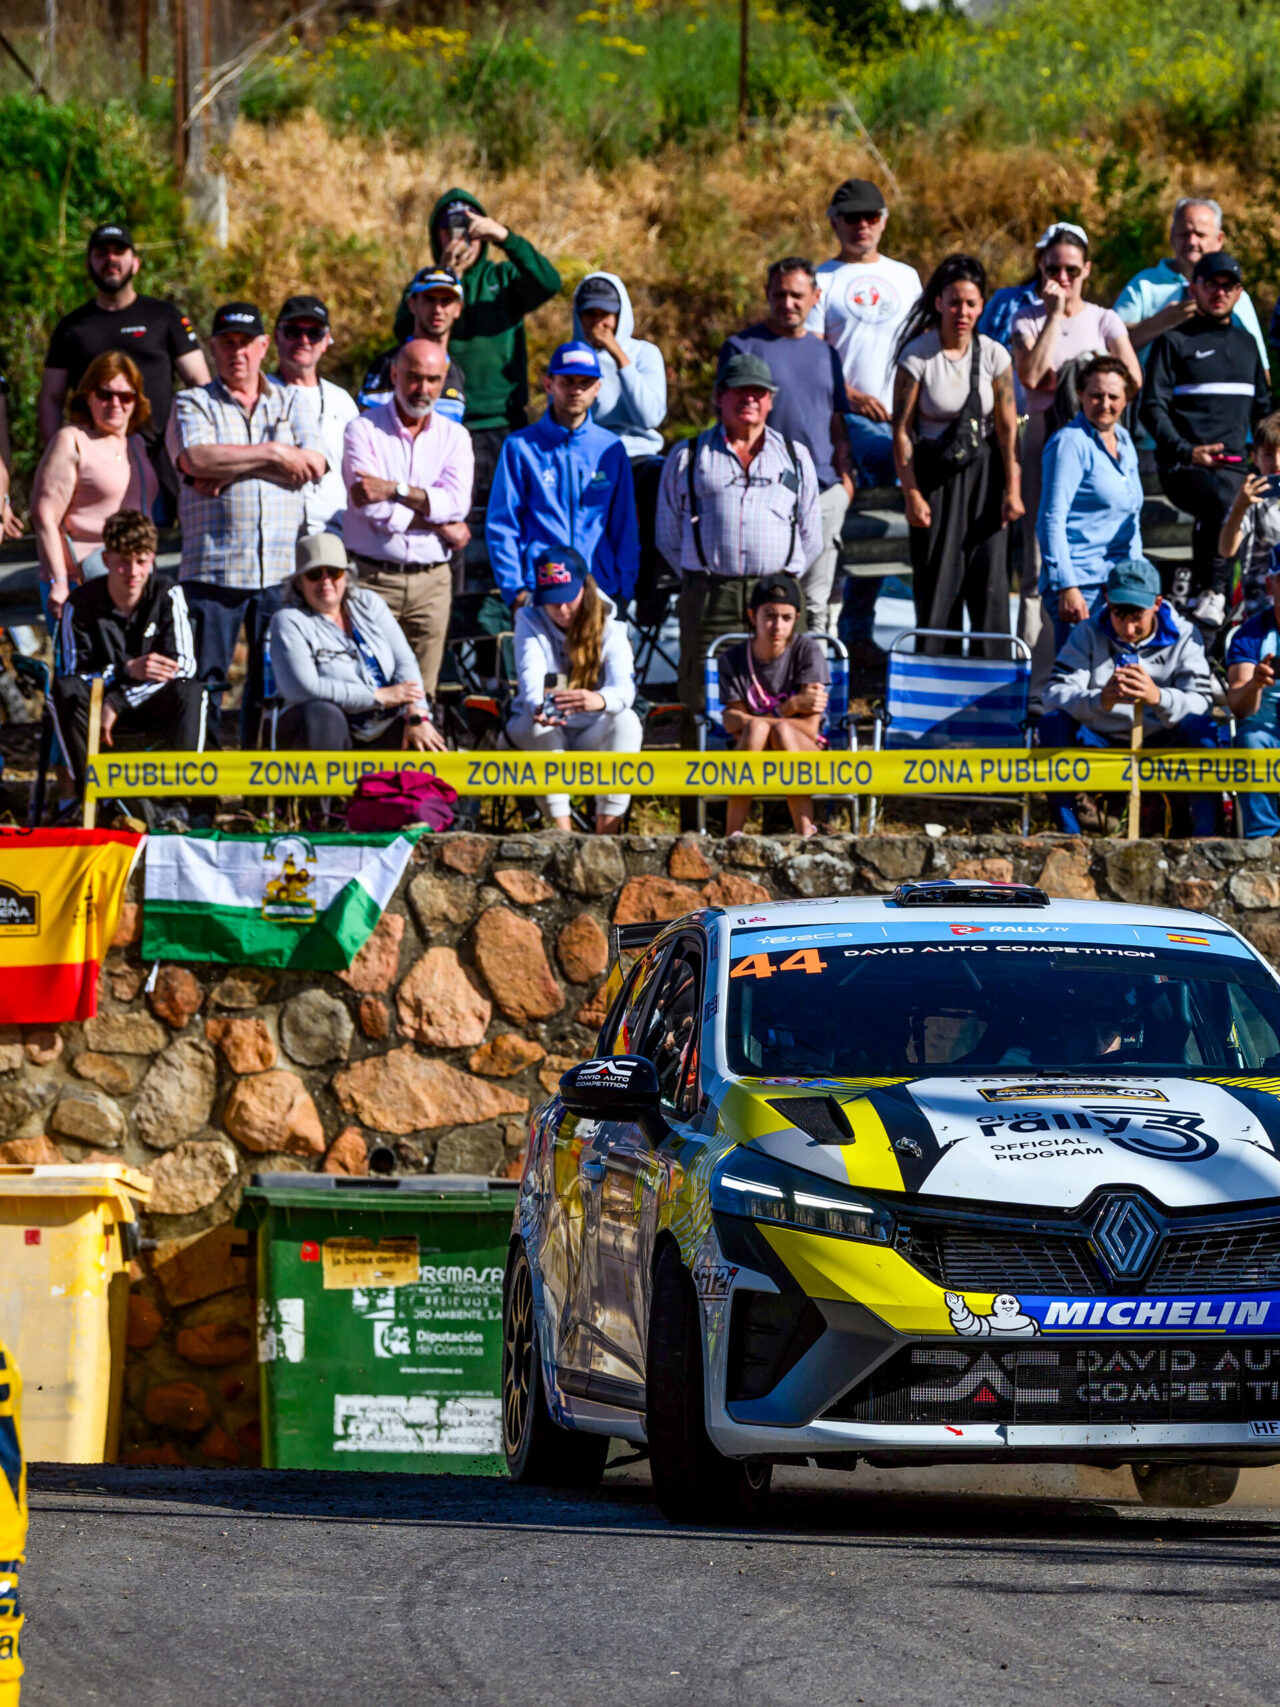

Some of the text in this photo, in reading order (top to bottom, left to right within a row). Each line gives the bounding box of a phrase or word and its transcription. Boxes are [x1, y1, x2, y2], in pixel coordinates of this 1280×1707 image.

[107, 762, 218, 788] PUBLICO
[249, 761, 318, 786] ZONA
[467, 761, 654, 786] ZONA PUBLICO
[685, 760, 873, 786] ZONA PUBLICO
[904, 757, 1090, 784] ZONA PUBLICO
[1122, 757, 1191, 783] ZONA
[729, 948, 828, 979] 44
[844, 945, 1156, 959] DAVID AUTO COMPETITION
[575, 1081, 628, 1089] COMPETITION
[603, 1075, 630, 1083] AUTO
[976, 1111, 1043, 1123] CLIO
[978, 1113, 1133, 1137] rally
[990, 1137, 1089, 1152] OFFICIAL
[994, 1147, 1104, 1161] PROGRAM
[1043, 1301, 1271, 1325] MICHELIN
[416, 1330, 484, 1344] Diputación
[415, 1343, 484, 1356] de Córdoba
[1076, 1349, 1197, 1372] DAVID
